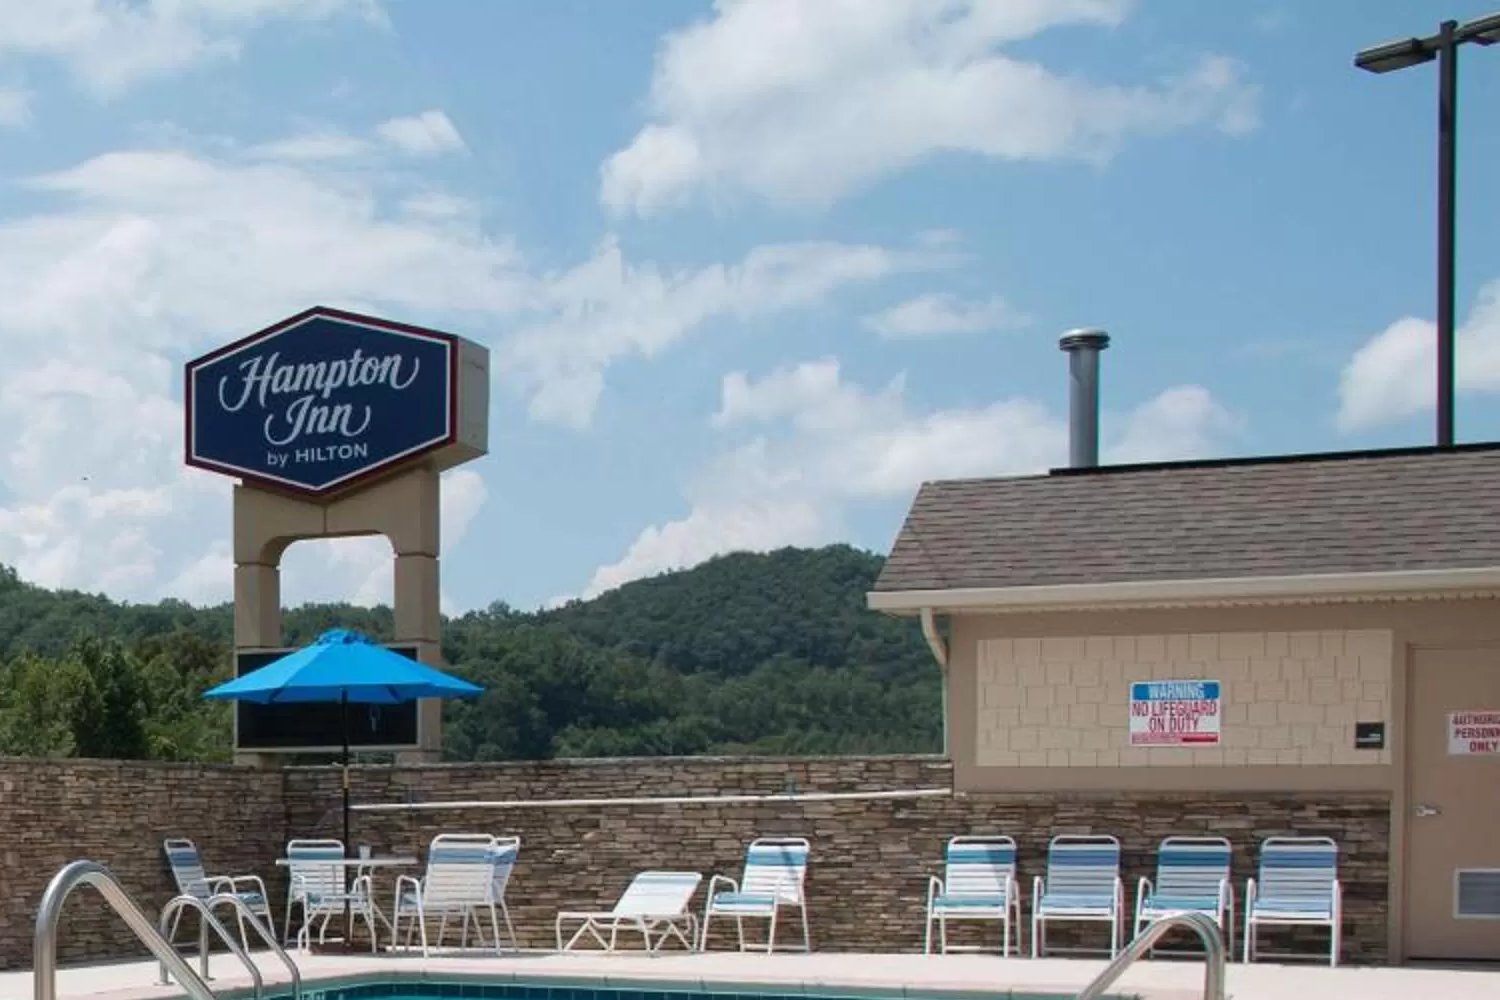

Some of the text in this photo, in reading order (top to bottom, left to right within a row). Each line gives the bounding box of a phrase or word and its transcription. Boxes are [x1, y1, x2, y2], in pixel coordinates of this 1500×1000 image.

[219, 348, 420, 412] Hampton
[264, 394, 371, 445] Inn
[267, 443, 367, 467] by HILTON
[1148, 682, 1205, 699] WARNING
[1131, 701, 1217, 717] NO LIFEGUARD
[1149, 716, 1199, 732] ON DUTY
[1469, 741, 1497, 753] ONLY
